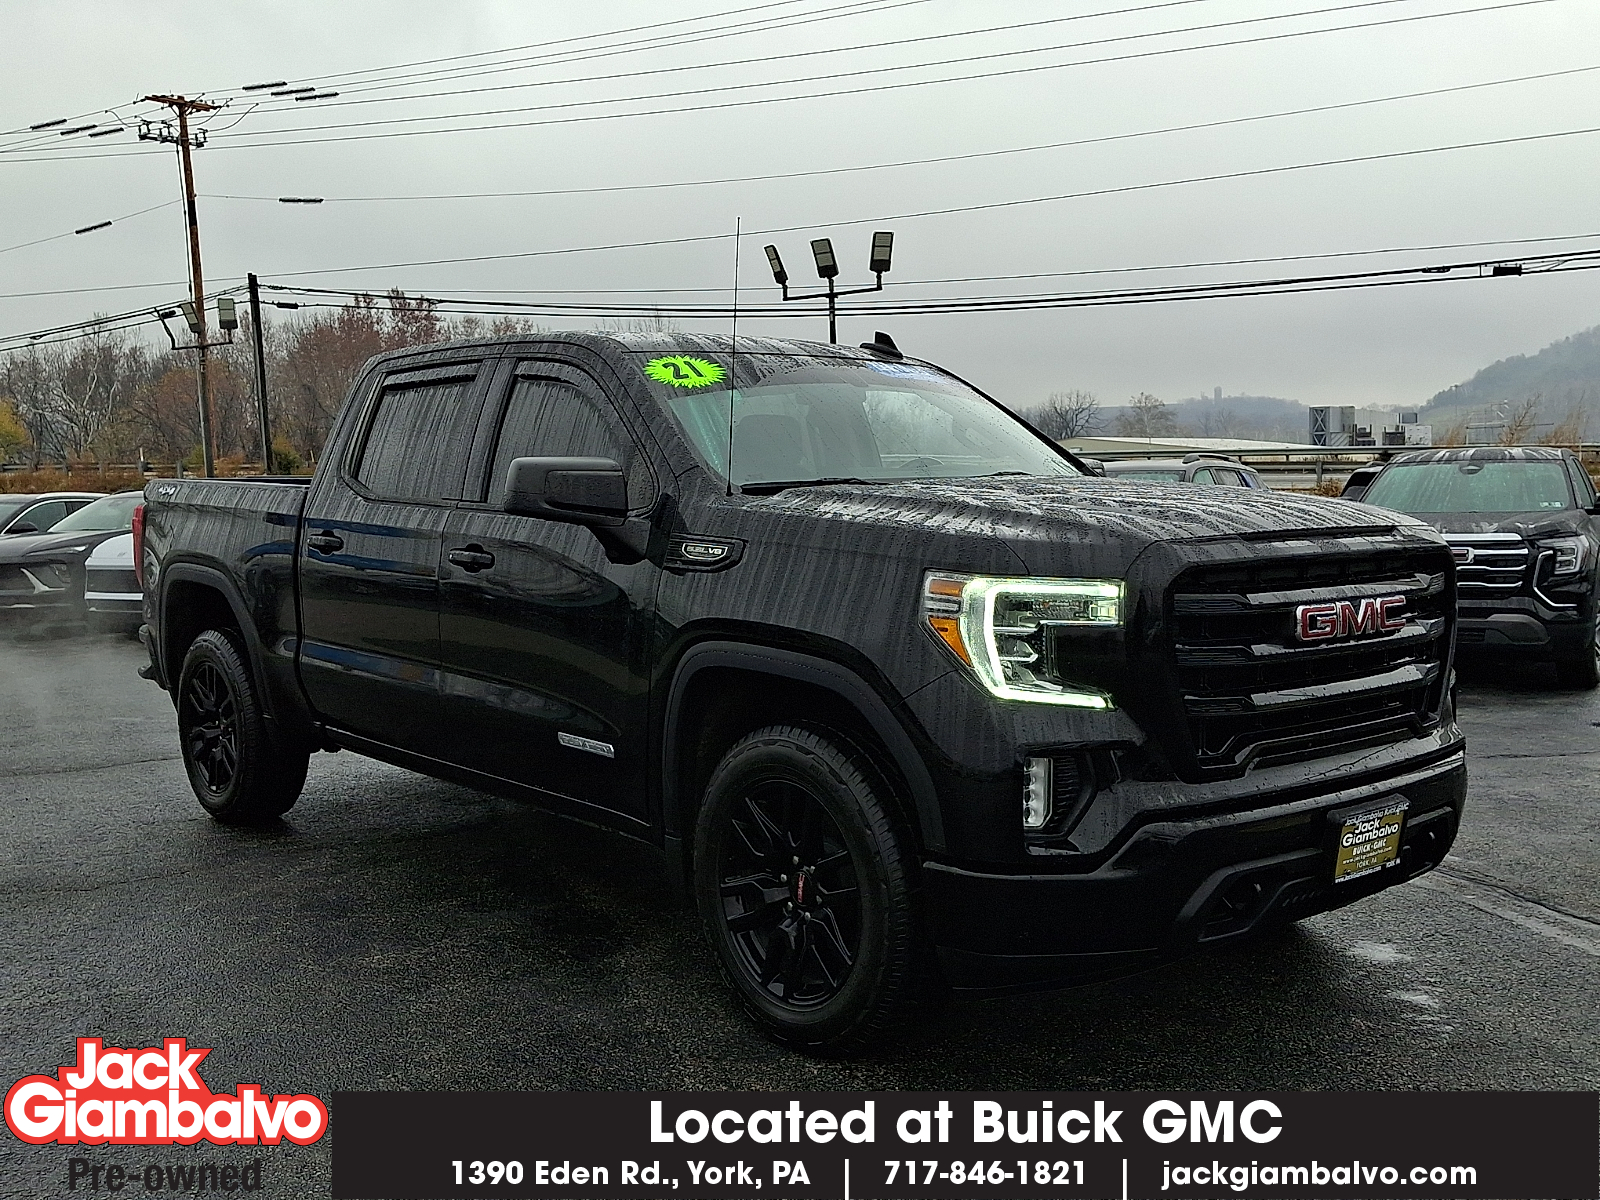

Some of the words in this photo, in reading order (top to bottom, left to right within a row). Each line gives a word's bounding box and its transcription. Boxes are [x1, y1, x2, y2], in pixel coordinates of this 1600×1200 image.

[661, 360, 705, 380] 21
[1296, 595, 1406, 640] GMC
[1342, 823, 1399, 847] Giambalvo
[1355, 818, 1380, 834] Jack
